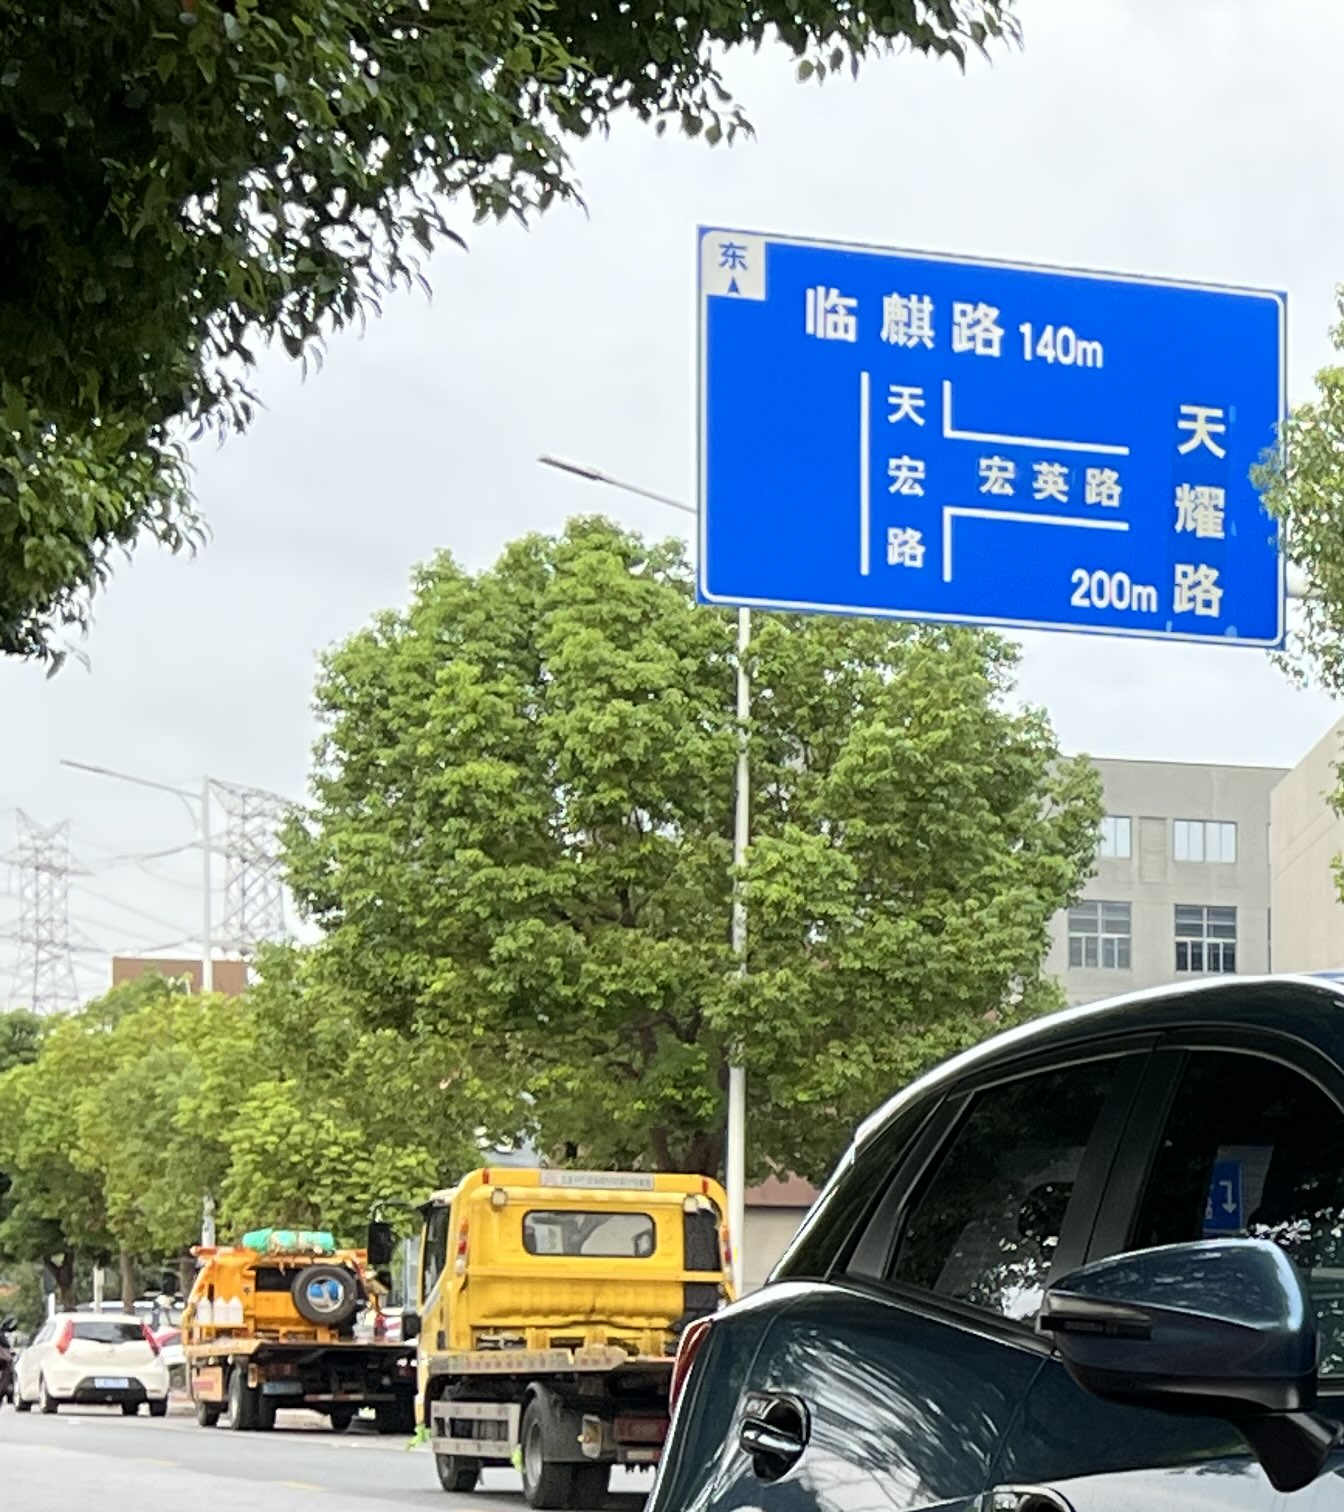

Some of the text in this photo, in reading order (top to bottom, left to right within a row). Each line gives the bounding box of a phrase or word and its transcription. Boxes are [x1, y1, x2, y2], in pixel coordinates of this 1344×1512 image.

[718, 242, 748, 271] 东
[804, 285, 1104, 368] 临麒路 140m
[886, 384, 926, 568] 天宏路
[978, 455, 1122, 507] 宏英路
[1173, 404, 1226, 618] 天耀路
[1070, 568, 1158, 613] 200m
